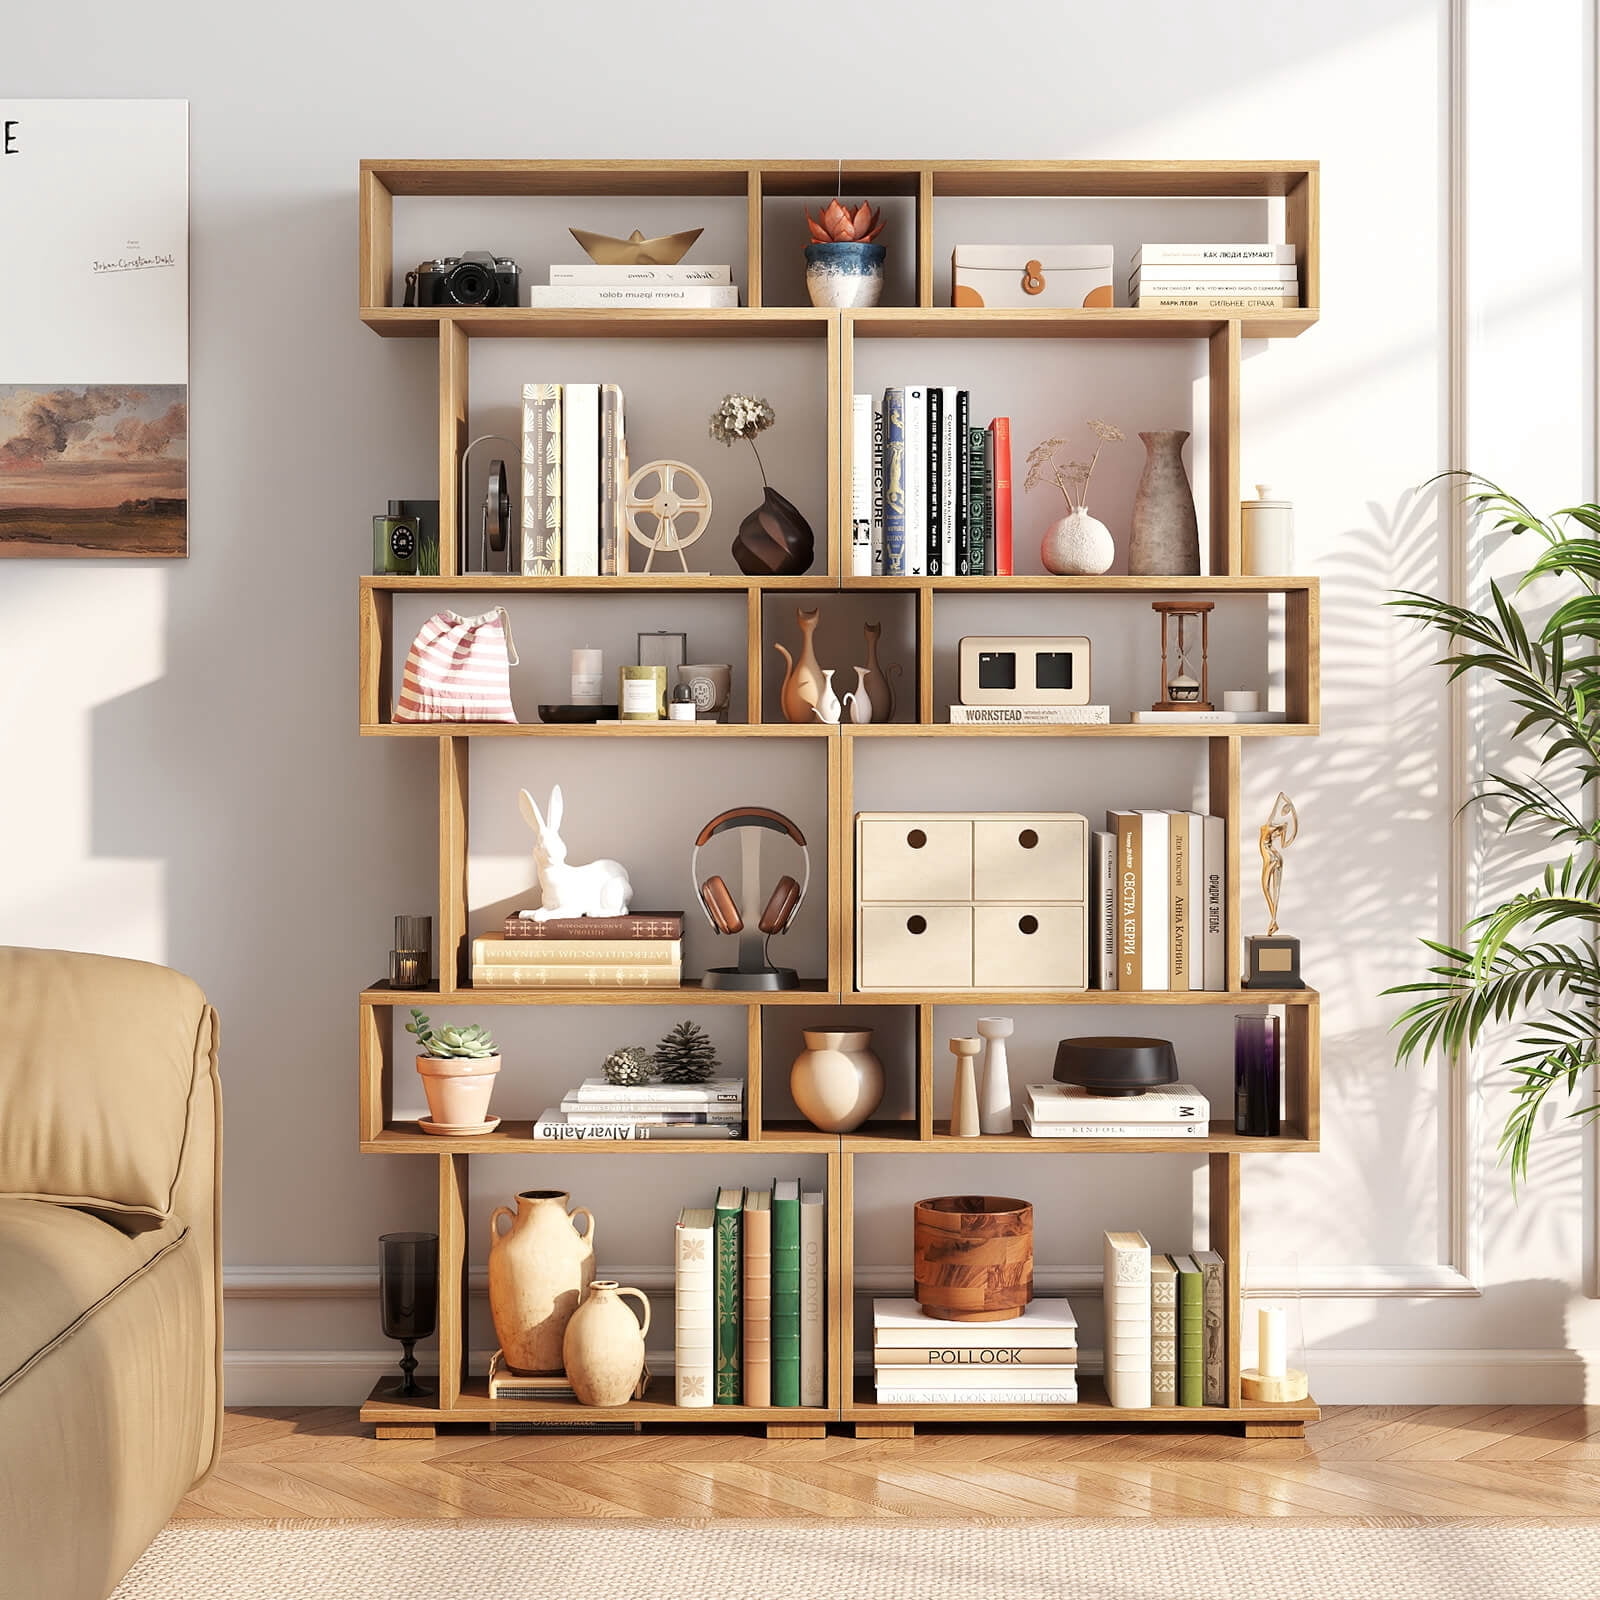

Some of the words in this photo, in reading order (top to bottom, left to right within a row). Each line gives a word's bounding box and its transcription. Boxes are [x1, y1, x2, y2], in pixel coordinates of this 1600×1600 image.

[1219, 251, 1241, 260] ЛЮДИ
[1209, 300, 1244, 308] СИЛЬНЕЕ
[1247, 300, 1275, 308] СТРАХА
[874, 411, 883, 528] ARCHITECTURE
[966, 709, 1022, 721] WORKSTEAD
[1124, 872, 1135, 916] СЕСТРА
[1208, 874, 1220, 905] ФРИДРИХ
[1208, 906, 1220, 934] ЭНГЕЛЬС
[1124, 918, 1135, 955] КЕРРИ
[928, 1350, 1022, 1364] POLLOCK
[922, 1392, 949, 1402] NEW
[953, 1392, 986, 1402] LOOK
[990, 1392, 1068, 1402] REVOLUTION
